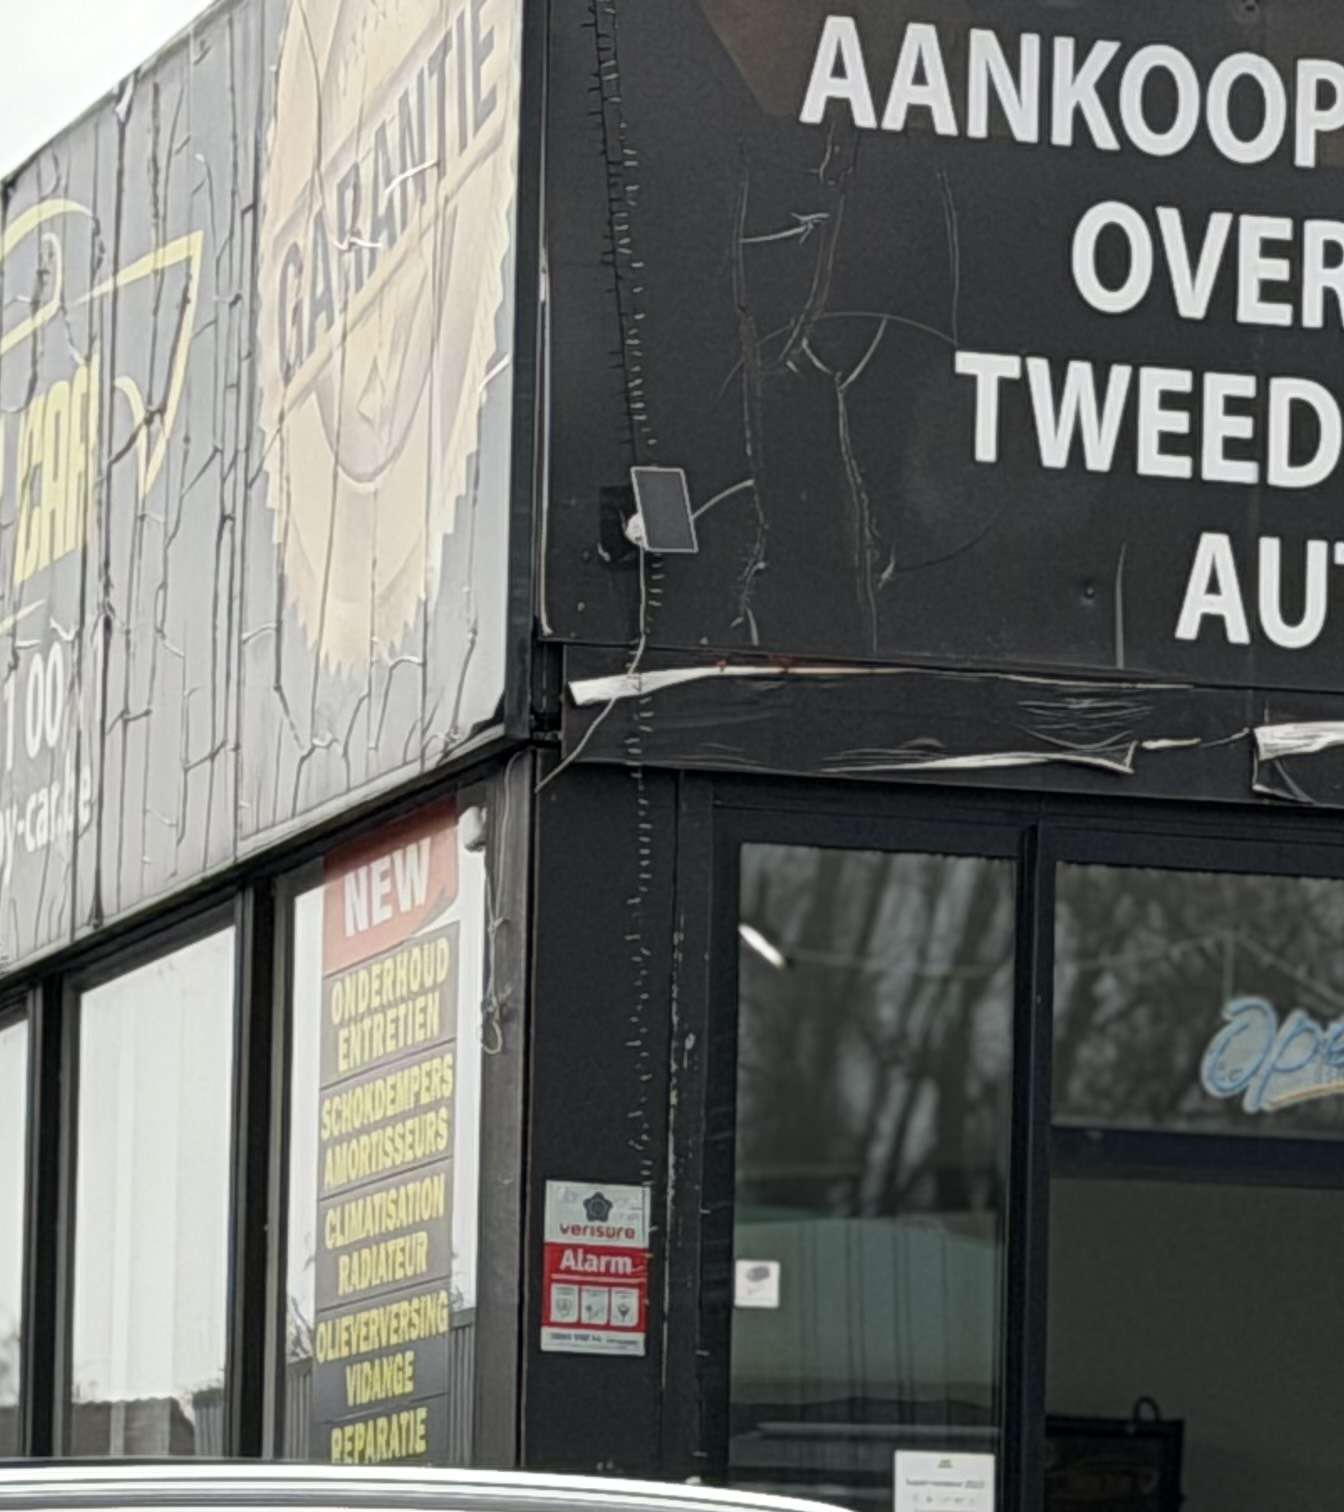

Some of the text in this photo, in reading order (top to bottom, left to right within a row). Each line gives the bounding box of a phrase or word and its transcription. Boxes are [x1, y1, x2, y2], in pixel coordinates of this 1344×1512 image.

[277, 0, 498, 389] GARANTIE
[343, 837, 432, 938] NEW
[331, 937, 450, 1025] ONDERHOUD
[337, 991, 441, 1073] ENTRETIEN
[320, 1053, 454, 1141] SCHOKDEMPERS
[324, 1106, 449, 1191] AMORTISSEURS
[324, 1173, 446, 1249] CLIMATISATION
[559, 1223, 636, 1240] verisure
[338, 1231, 429, 1296] RADIATEUR
[559, 1248, 634, 1275] Alarm
[315, 1290, 450, 1364] OLIEVERVERSING
[345, 1350, 415, 1407] VIDANGE
[330, 1407, 428, 1465] REPARATIE
